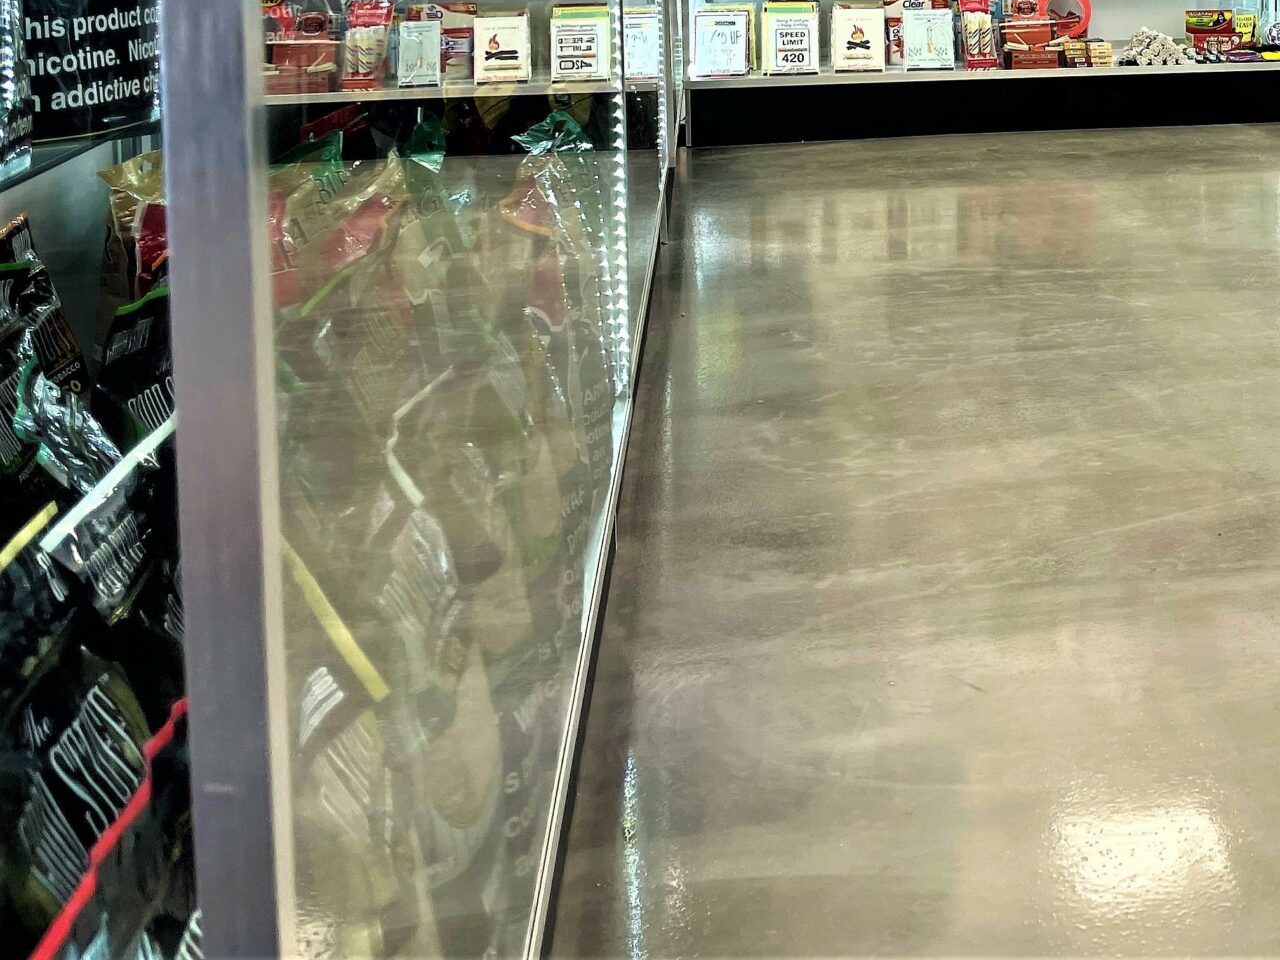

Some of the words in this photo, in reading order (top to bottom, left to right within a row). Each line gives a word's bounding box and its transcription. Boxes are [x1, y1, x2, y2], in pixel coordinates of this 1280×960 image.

[25, 15, 66, 40] his
[73, 6, 142, 41] product
[779, 31, 806, 39] SPEED
[781, 53, 805, 63] 420
[51, 76, 141, 111] addictive
